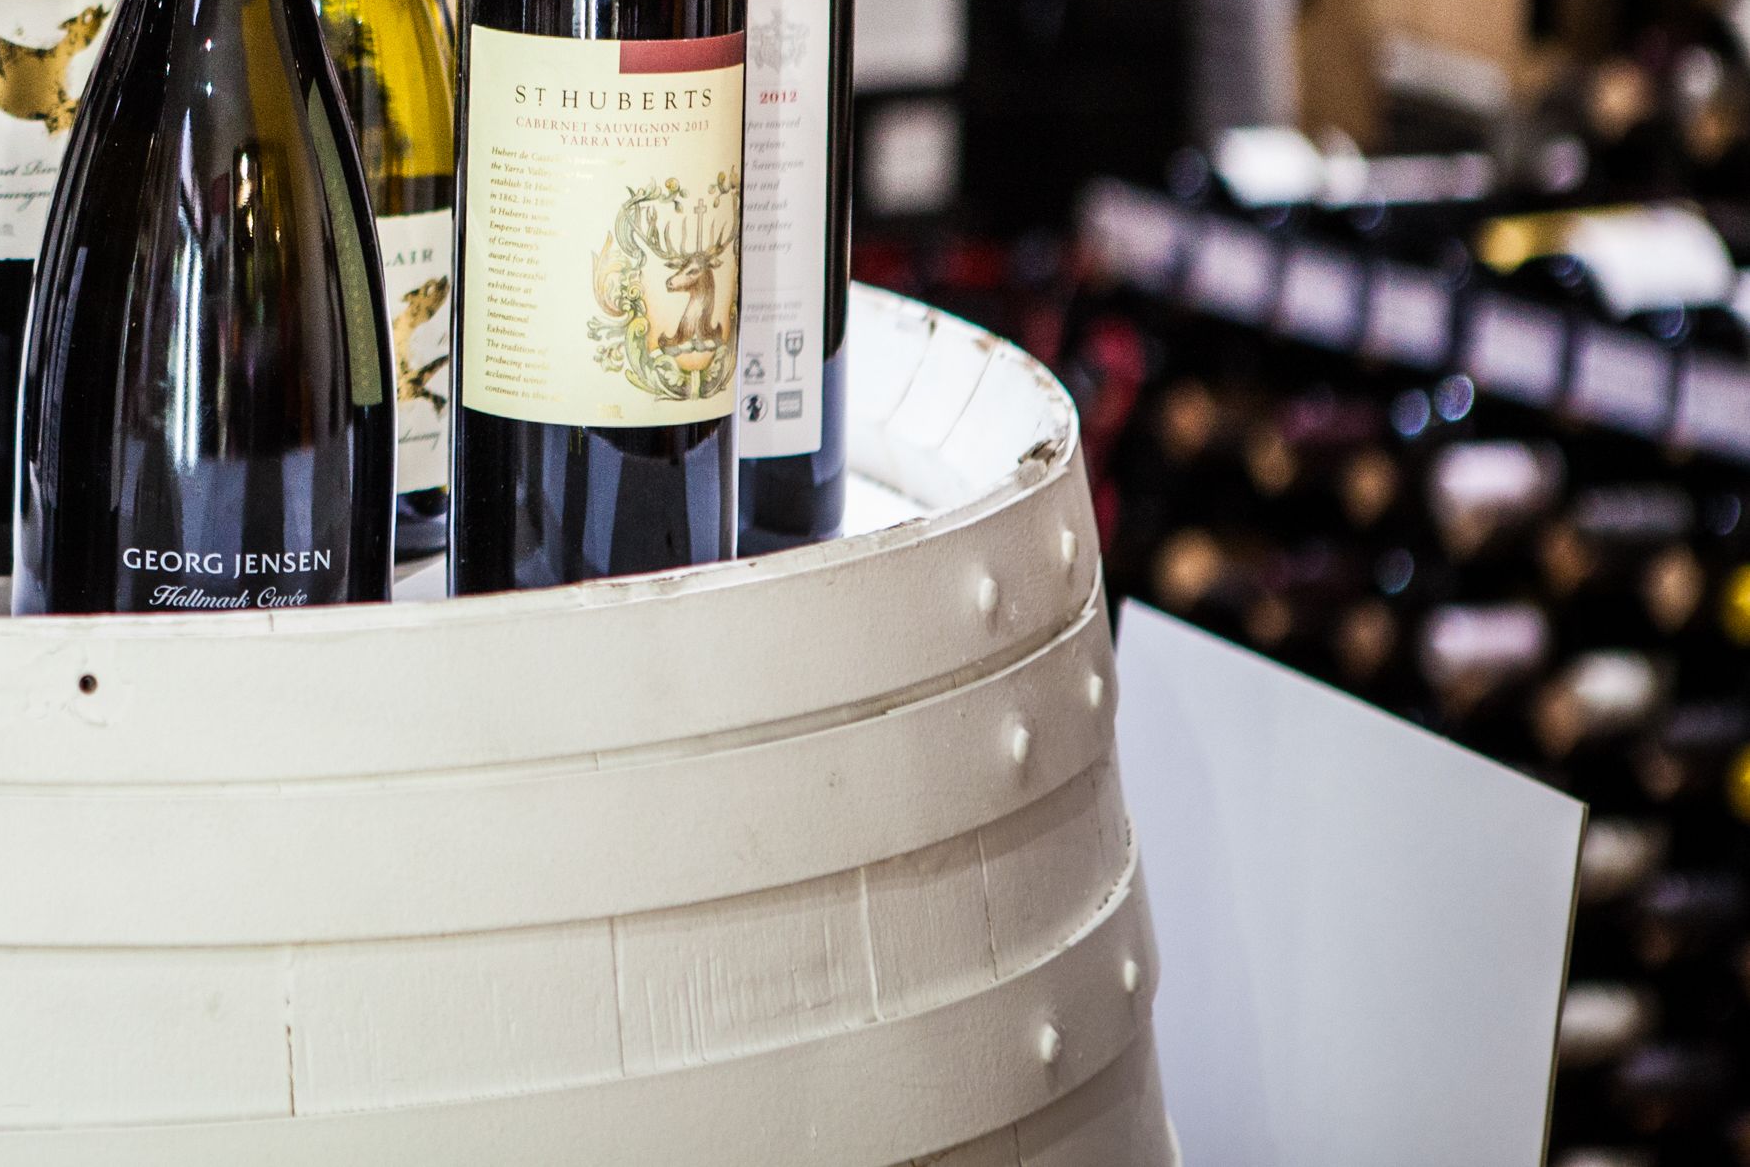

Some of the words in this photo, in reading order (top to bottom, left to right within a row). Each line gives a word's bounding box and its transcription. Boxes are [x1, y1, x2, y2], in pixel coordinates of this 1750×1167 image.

[562, 88, 712, 111] HUBERTS
[760, 91, 797, 105] 2012
[516, 116, 588, 133] CABERNET
[595, 120, 681, 134] SAUVIGNON
[560, 134, 610, 147] YARRA
[617, 135, 671, 147] VALLEY
[386, 248, 434, 267] AIR
[122, 547, 224, 574] GEORG
[234, 549, 332, 579] JENSEN
[149, 584, 251, 609] Hallmark
[256, 586, 309, 608] Cuvée
